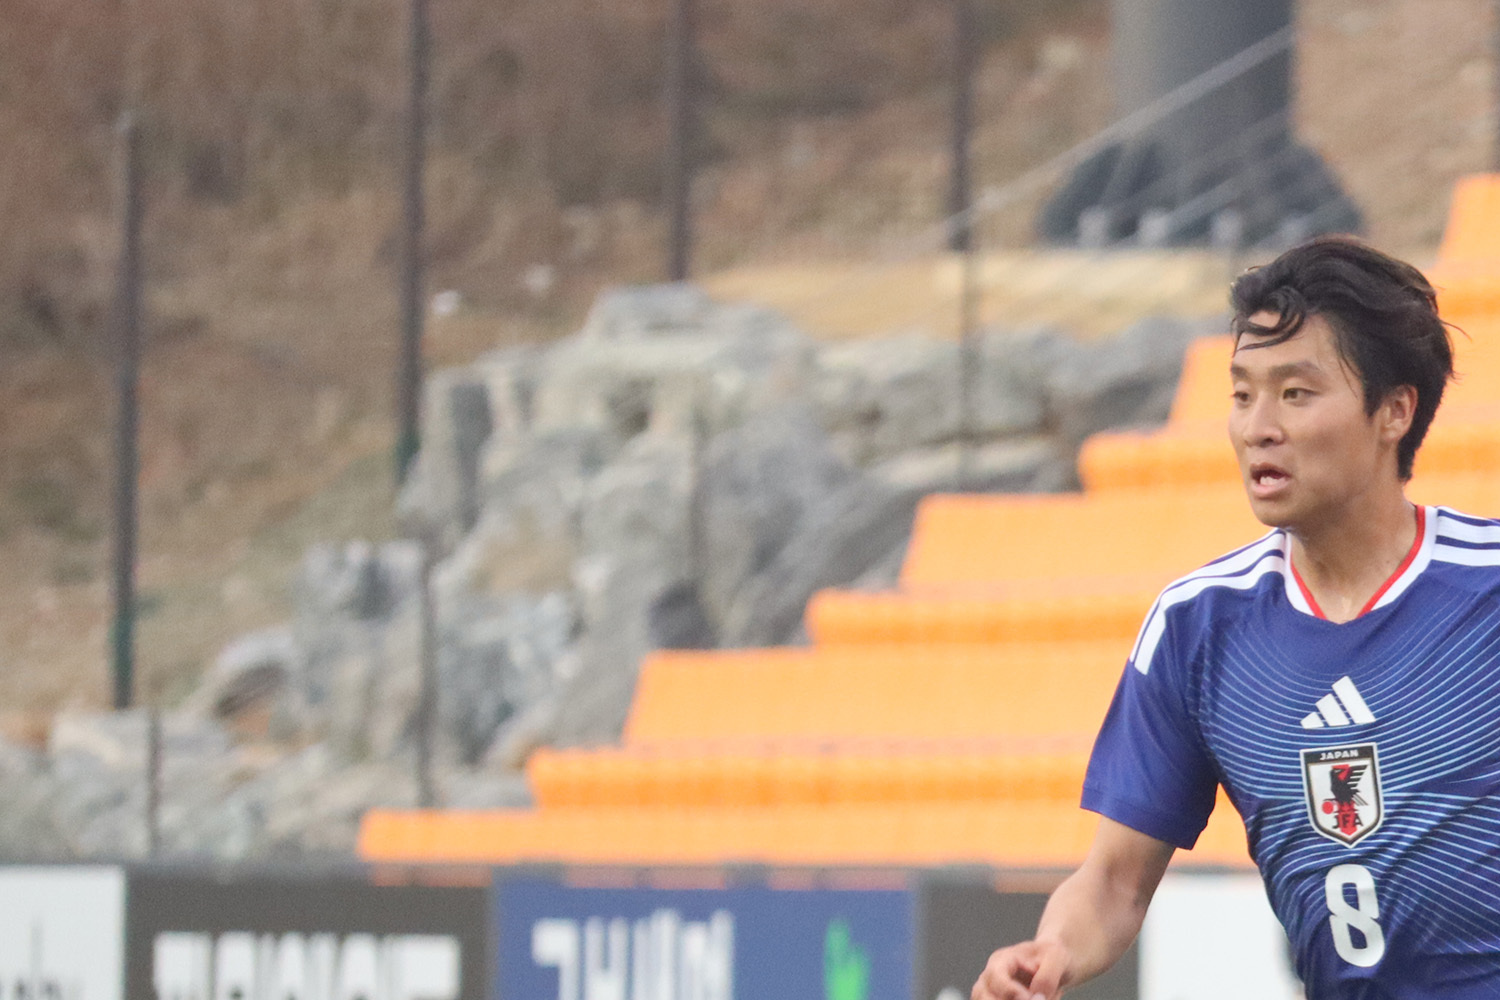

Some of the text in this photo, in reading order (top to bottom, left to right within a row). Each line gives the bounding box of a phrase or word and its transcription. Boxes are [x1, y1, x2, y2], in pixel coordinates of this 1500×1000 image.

[1320, 750, 1359, 760] JAPAN
[1332, 812, 1363, 829] JFA
[1325, 864, 1385, 968] 8
